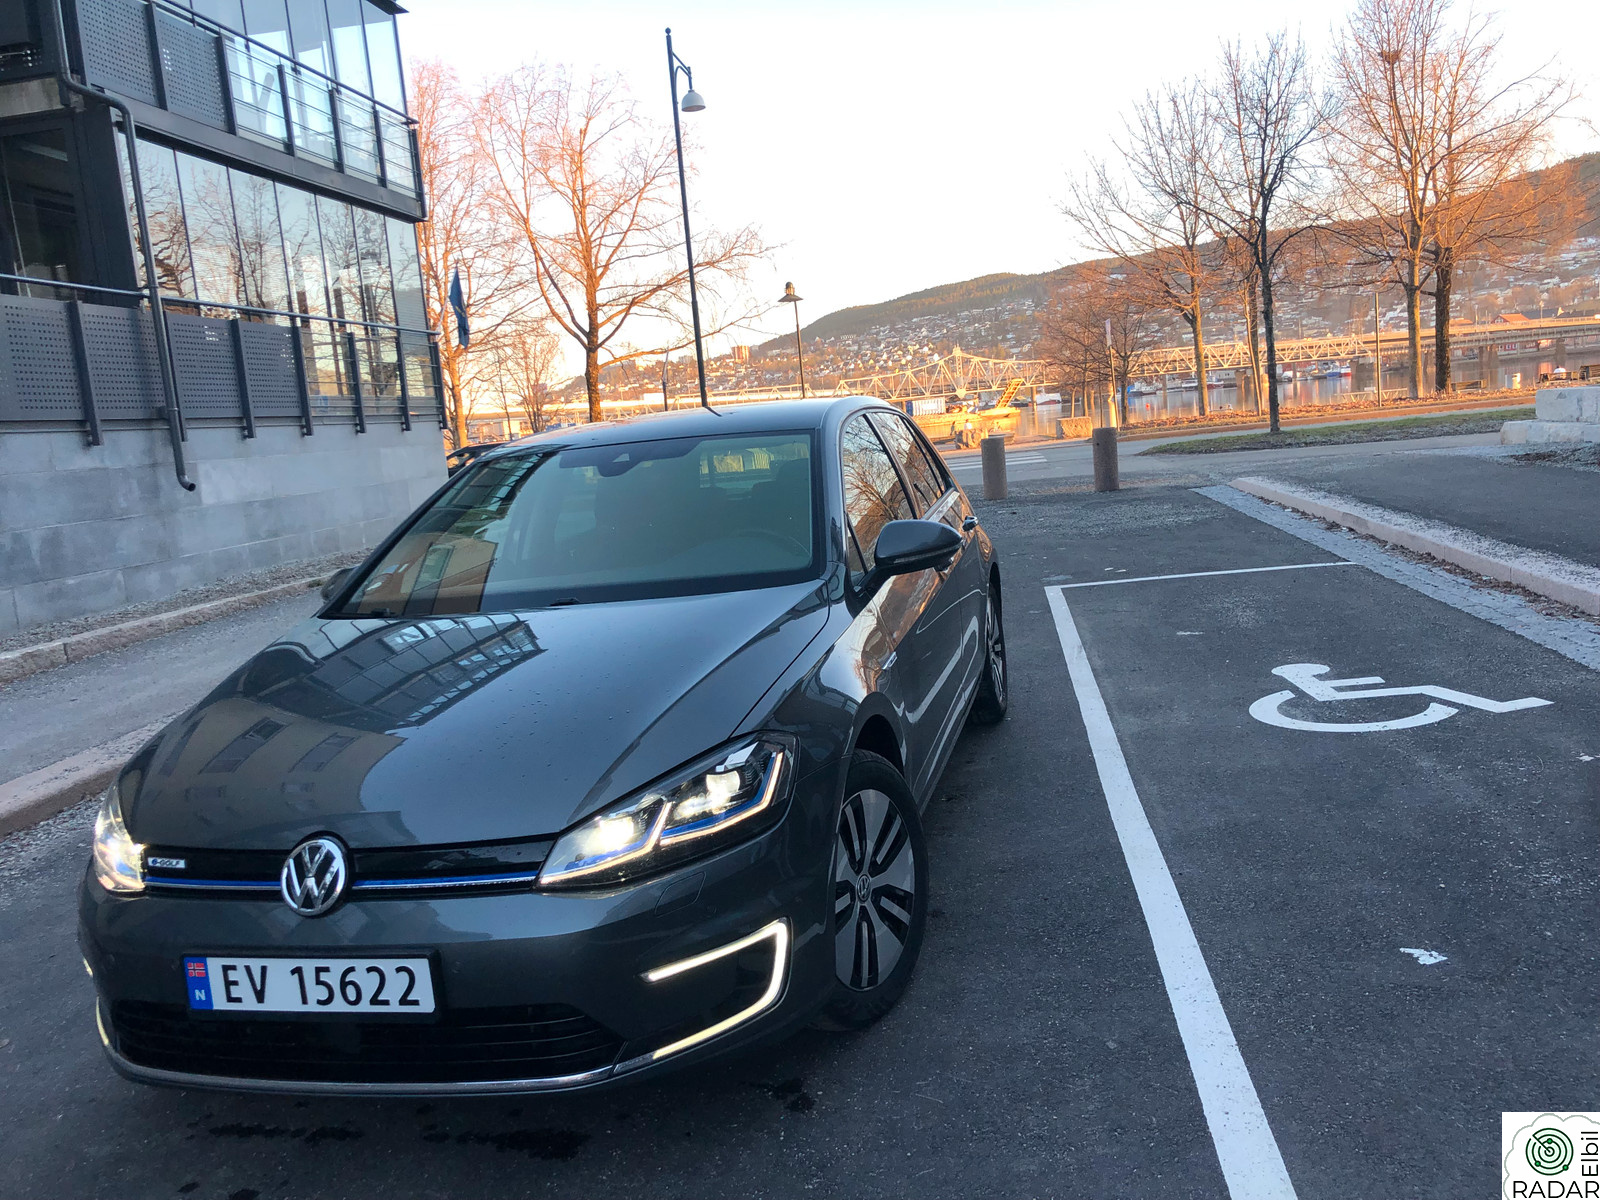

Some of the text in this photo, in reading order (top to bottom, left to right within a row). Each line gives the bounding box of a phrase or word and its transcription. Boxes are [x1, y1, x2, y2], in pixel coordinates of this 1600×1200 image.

[194, 989, 206, 1001] N
[221, 964, 420, 1007] EV 15622
